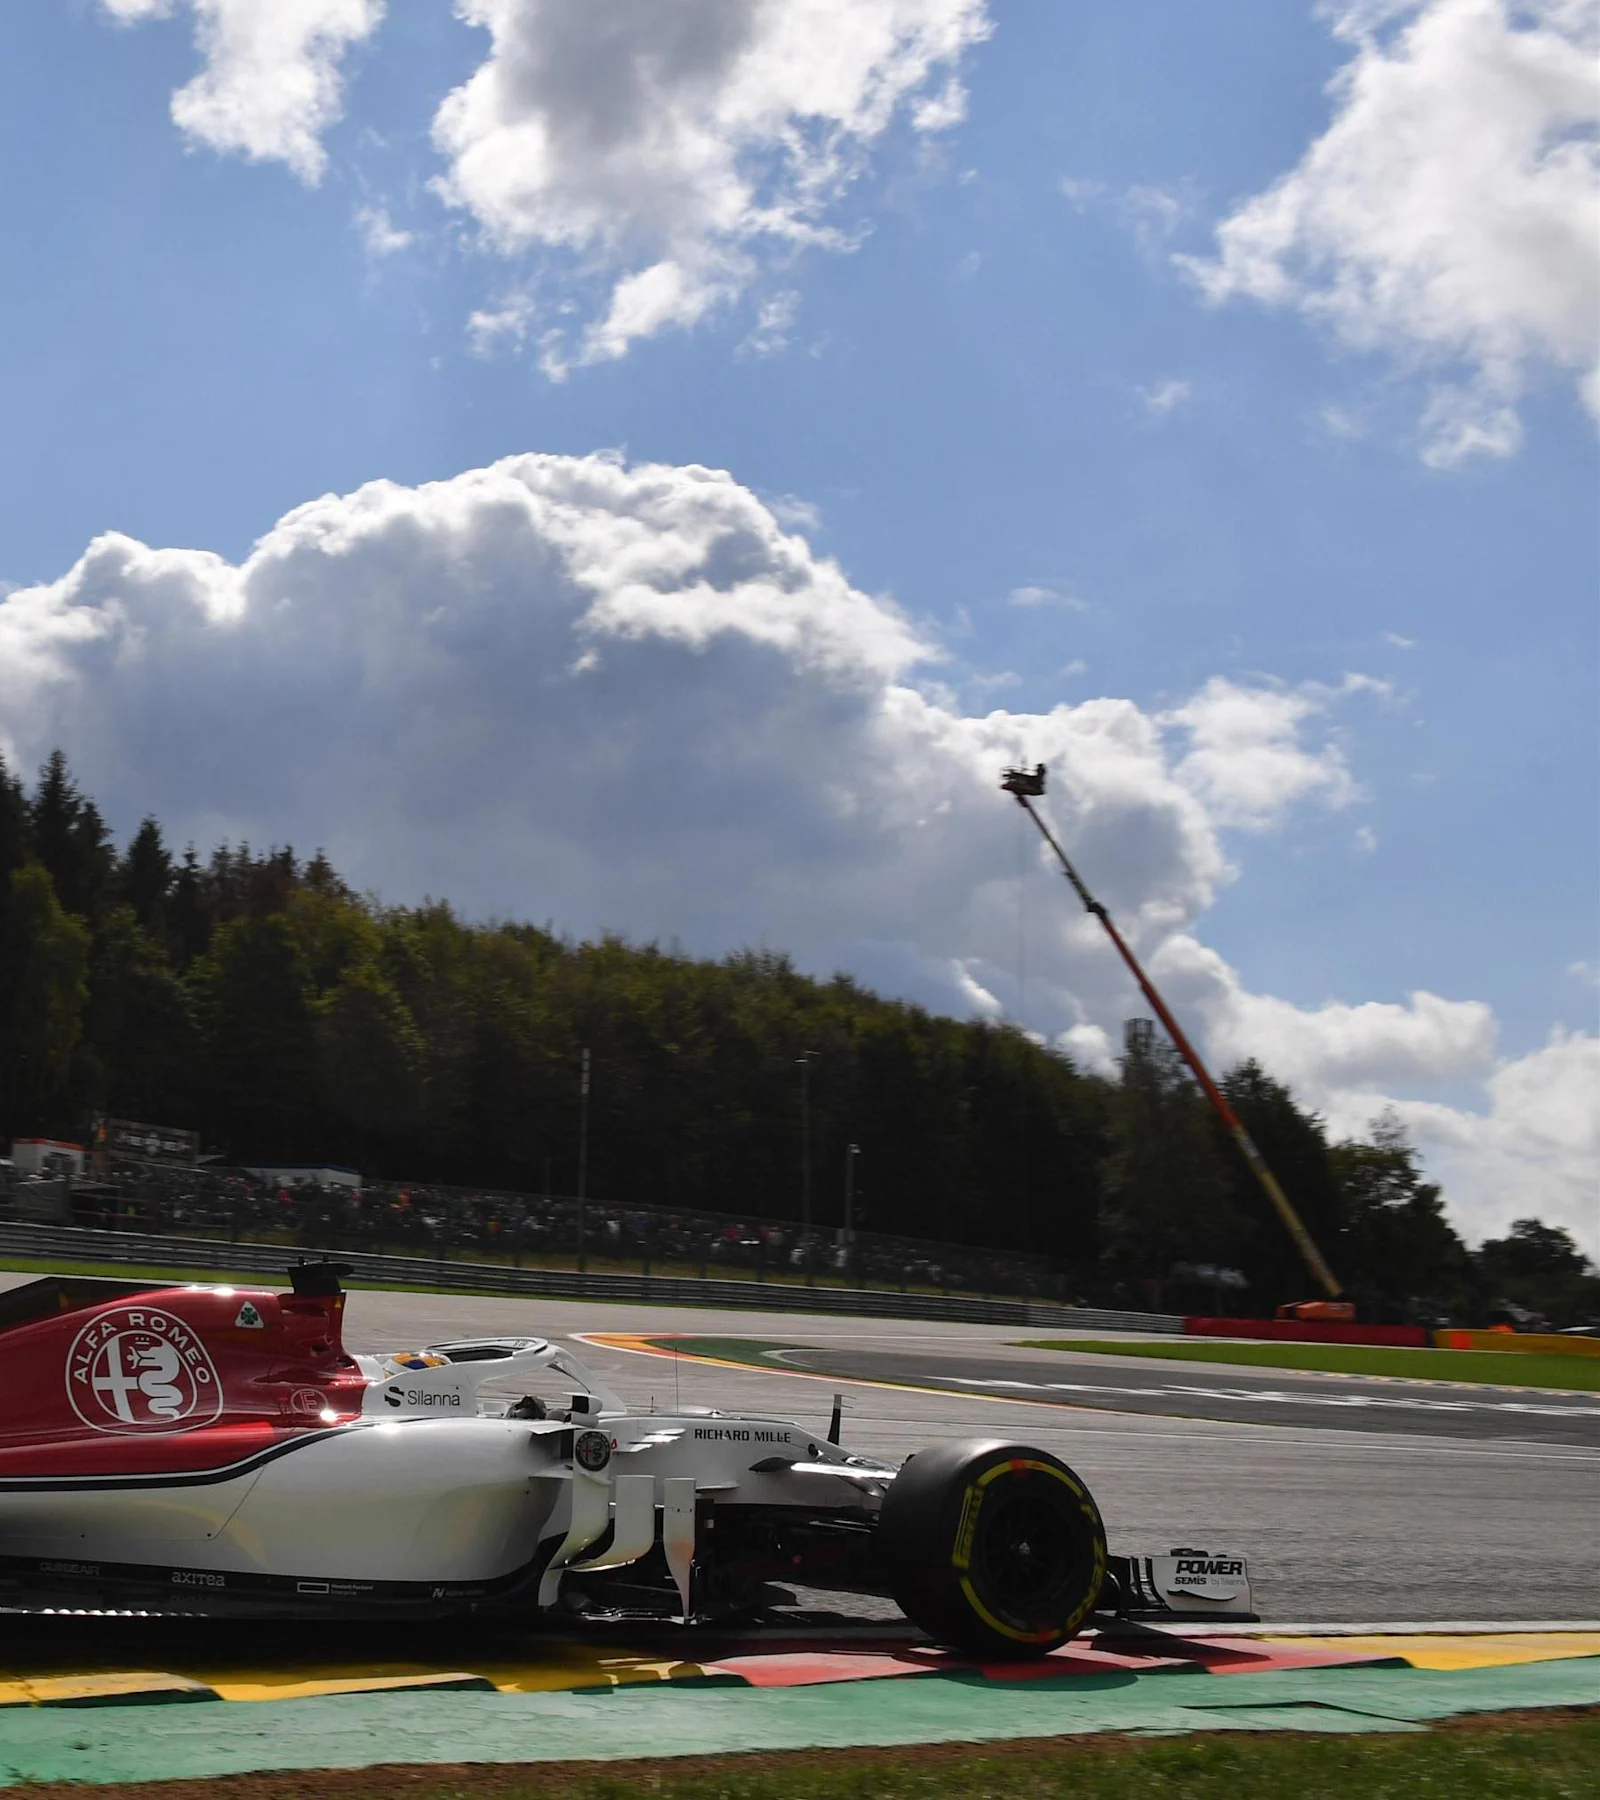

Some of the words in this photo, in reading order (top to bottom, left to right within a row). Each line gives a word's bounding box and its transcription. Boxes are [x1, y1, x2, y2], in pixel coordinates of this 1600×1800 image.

[74, 1321, 117, 1384] ALFA
[128, 1313, 210, 1383] ROMEO
[407, 1390, 461, 1406] Silanna
[694, 1428, 750, 1441] RICHARD
[754, 1431, 791, 1443] MILLE
[1176, 1560, 1243, 1575] POWER
